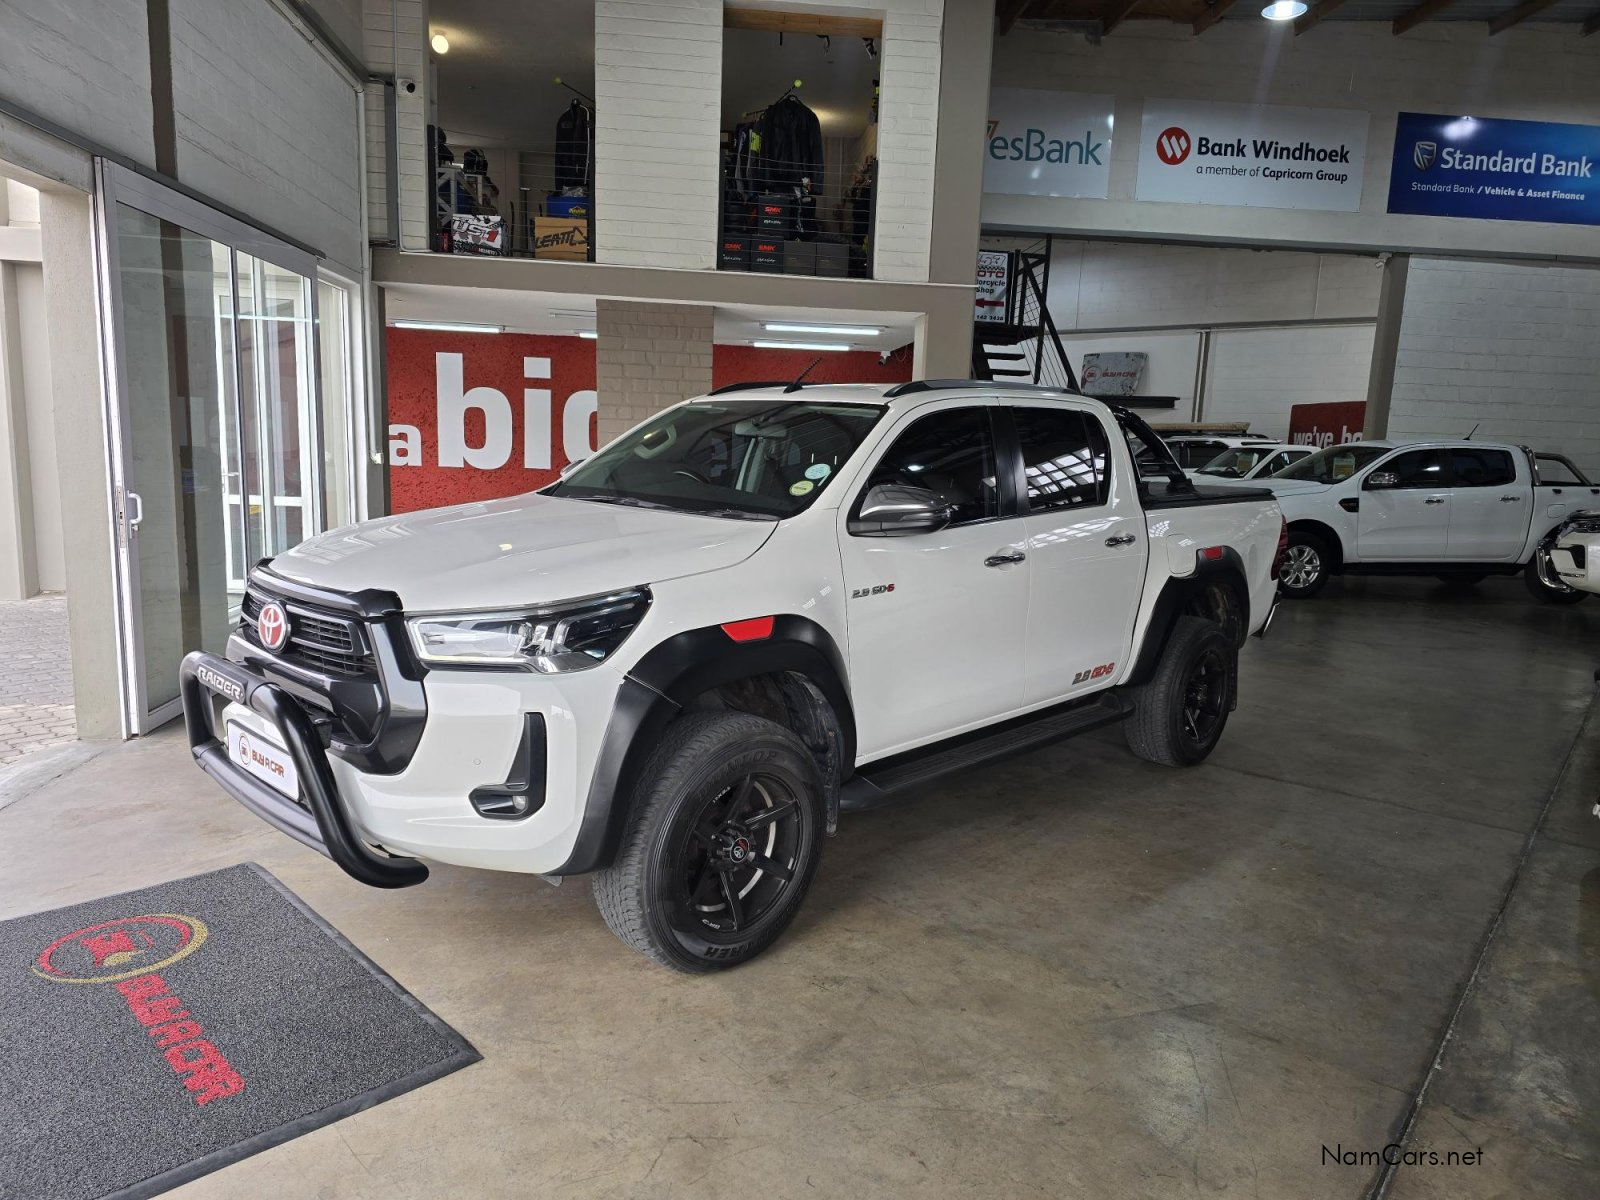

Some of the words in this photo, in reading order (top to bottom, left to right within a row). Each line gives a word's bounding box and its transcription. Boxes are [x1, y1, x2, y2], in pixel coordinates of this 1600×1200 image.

[1197, 137, 1247, 158] Bank
[1252, 139, 1350, 163] Windhoek
[1441, 147, 1537, 174] Standard
[1540, 154, 1592, 178] Bank
[1196, 166, 1203, 174] a
[1205, 165, 1247, 176] member
[1249, 166, 1260, 177] of
[1262, 167, 1313, 180] Capricorn
[1315, 170, 1348, 184] Group
[1411, 181, 1452, 193] Standard
[1453, 184, 1475, 194] Bank
[1484, 186, 1515, 196] Vehicle
[1517, 188, 1524, 197] &
[1526, 189, 1550, 199] Asset
[1551, 190, 1585, 200] Finance
[389, 423, 422, 467] a
[198, 666, 241, 700] RAIDER
[252, 750, 264, 767] BUY
[271, 760, 285, 778] CAR
